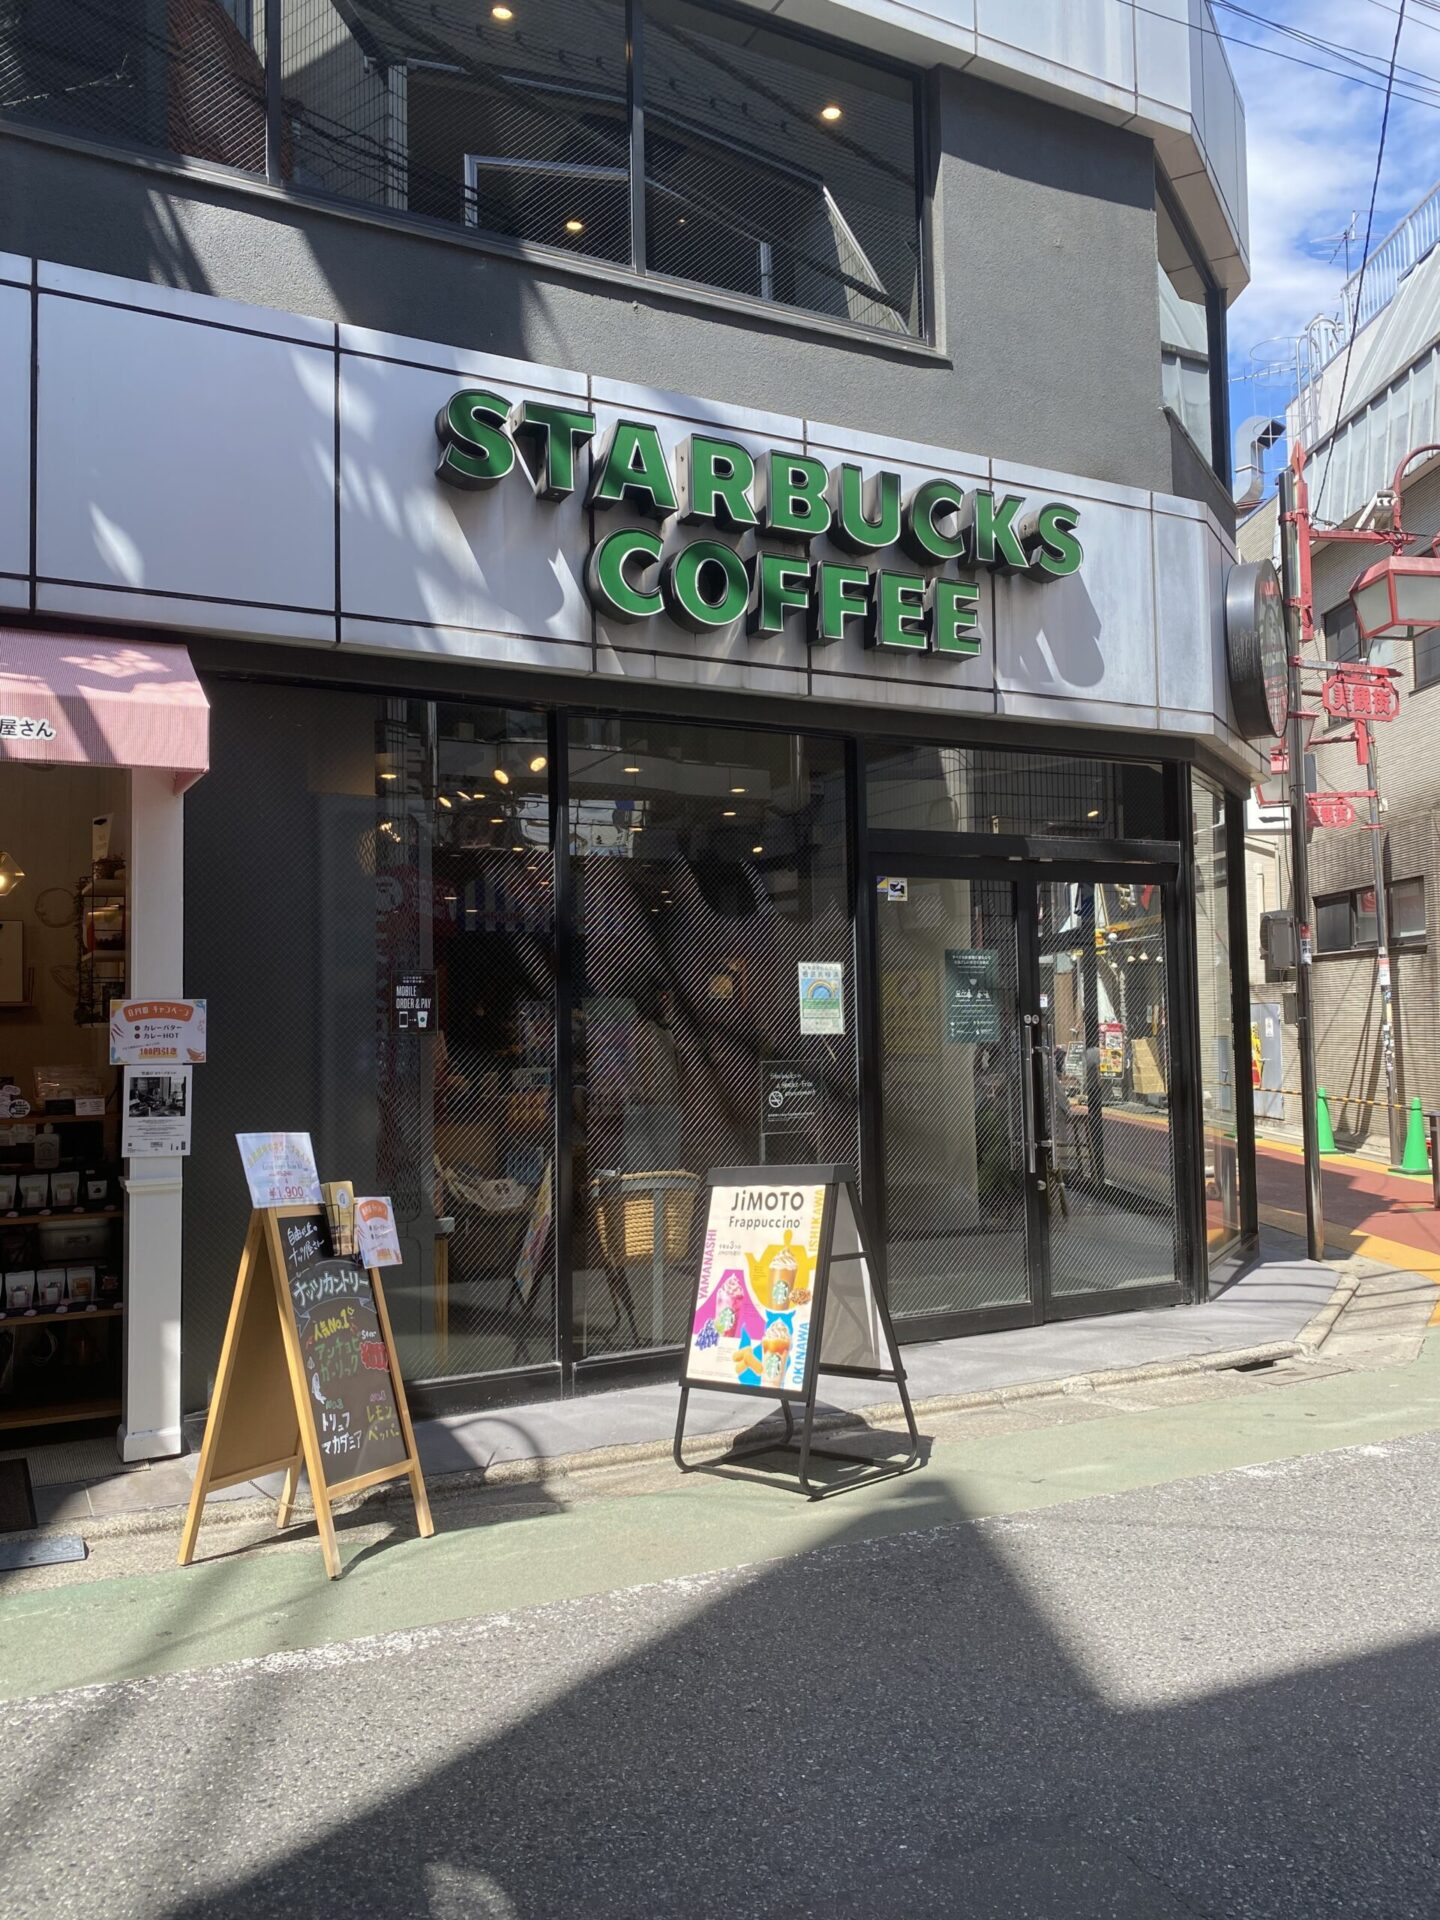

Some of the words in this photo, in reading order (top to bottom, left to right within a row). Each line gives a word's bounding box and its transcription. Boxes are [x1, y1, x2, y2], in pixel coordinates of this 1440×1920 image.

[436, 388, 1085, 583] STARBUCKS
[586, 526, 982, 660] COFFEE
[1332, 683, 1391, 716] 美観街
[0, 718, 53, 738] 屋さん
[396, 985, 417, 997] MOBILE
[396, 998, 414, 1009] ORDER
[415, 998, 420, 1009] &
[421, 998, 432, 1009] PAY
[143, 1023, 183, 1032] カレーバター
[143, 1032, 179, 1040] カレーHOT
[731, 1190, 804, 1213] JiMOTO
[729, 1216, 801, 1230] Frappuccino
[808, 1188, 824, 1252] ISHIKAWA
[698, 1229, 717, 1300] YAMANASHI
[293, 1270, 369, 1307] ナッツカントリー
[792, 1322, 810, 1385] OKINAWA
[322, 1411, 350, 1432] トリュフ
[366, 1405, 392, 1423] レモン
[321, 1429, 362, 1455] マカダミア
